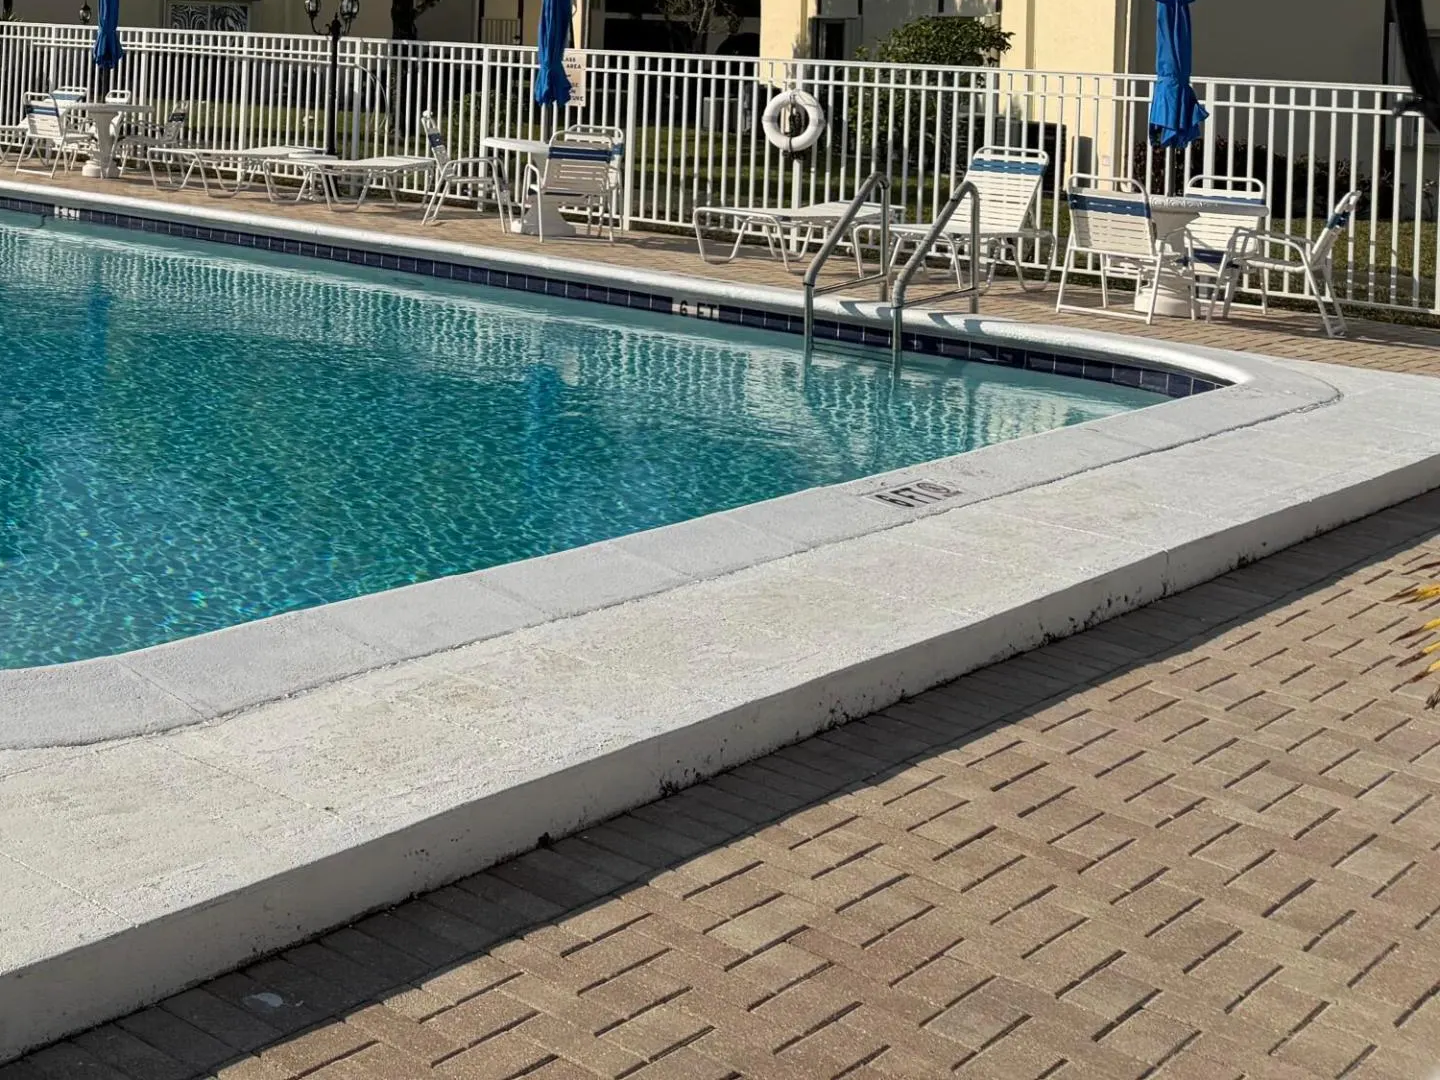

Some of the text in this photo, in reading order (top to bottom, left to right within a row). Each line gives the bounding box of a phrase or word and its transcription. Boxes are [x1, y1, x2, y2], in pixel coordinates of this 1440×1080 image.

[680, 300, 717, 319] 6 FT
[874, 494, 915, 508] 6
[889, 487, 943, 505] FT
